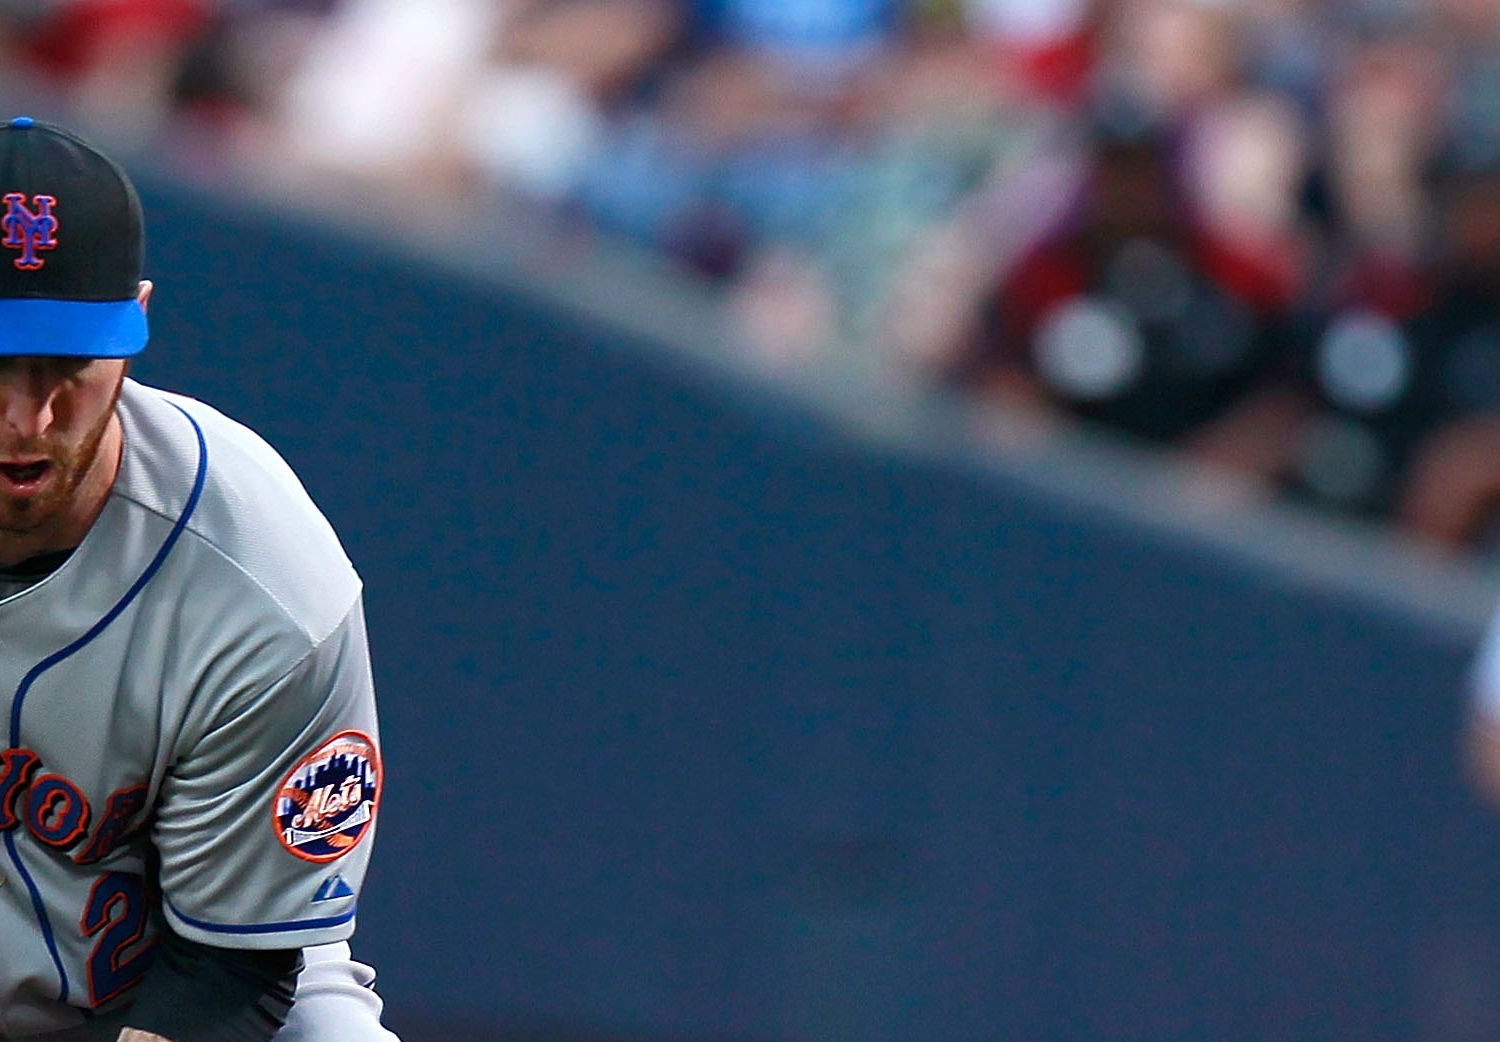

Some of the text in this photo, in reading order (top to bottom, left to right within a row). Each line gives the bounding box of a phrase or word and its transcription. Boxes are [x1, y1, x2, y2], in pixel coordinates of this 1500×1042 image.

[1, 192, 58, 271] NY
[291, 774, 363, 828] Mets
[79, 870, 158, 1008] 2
